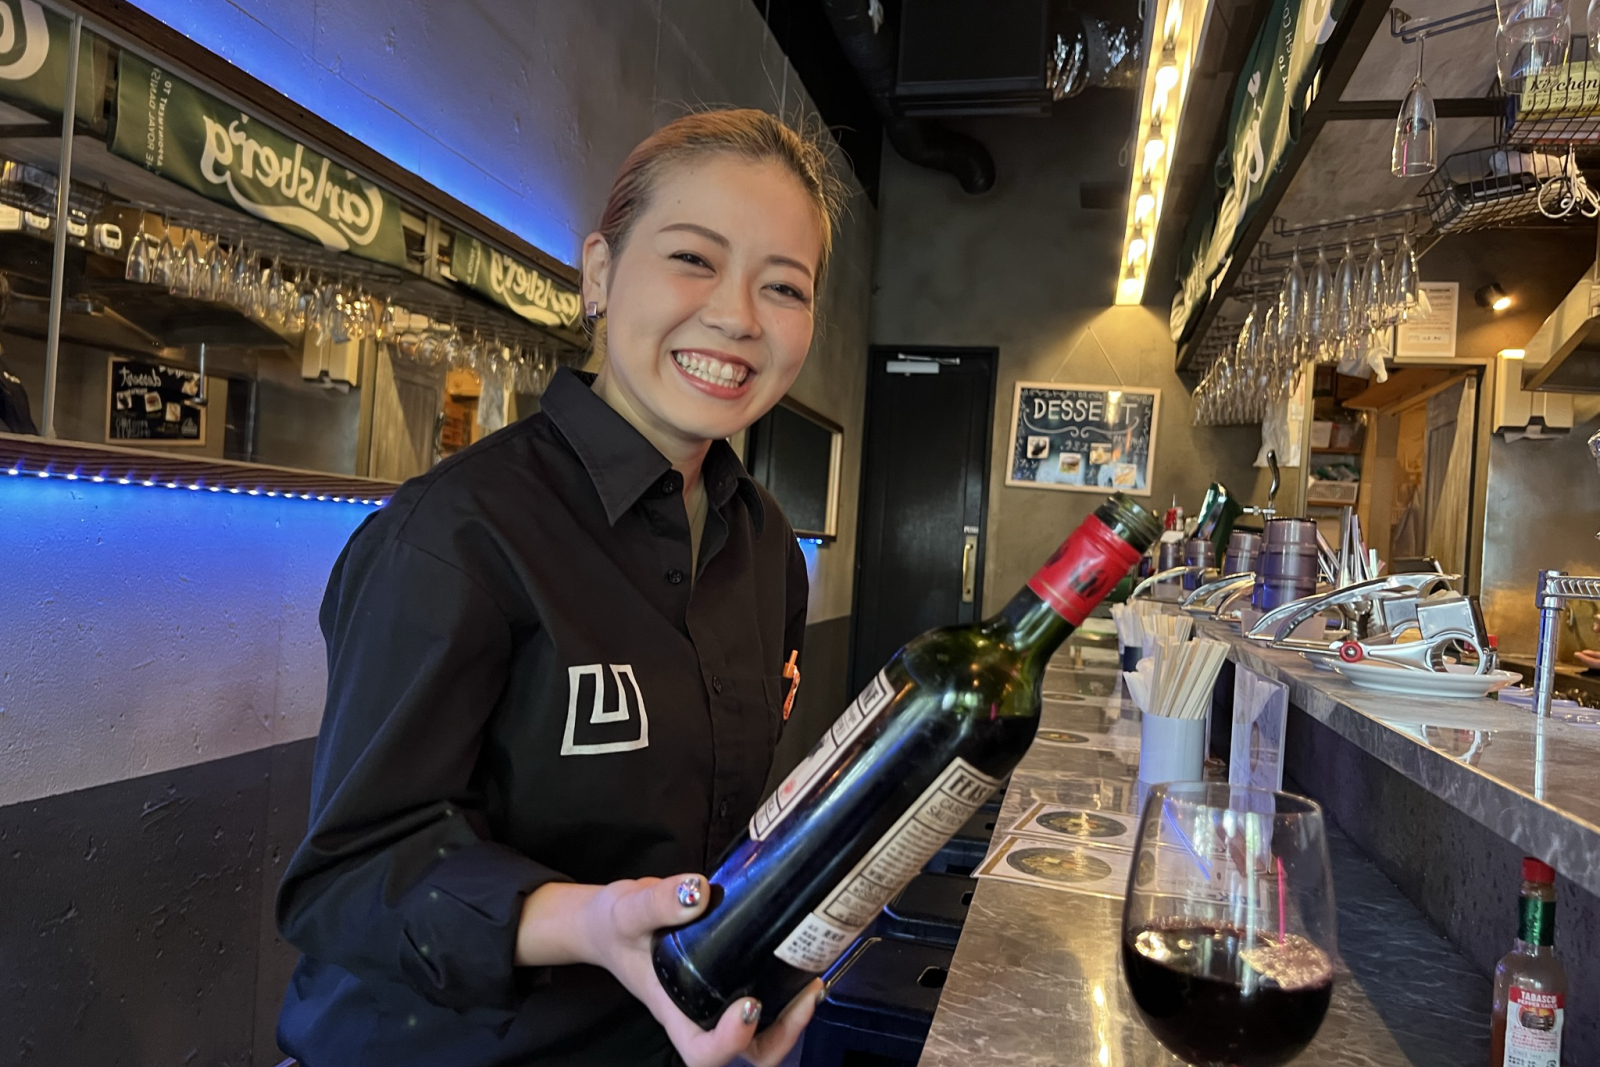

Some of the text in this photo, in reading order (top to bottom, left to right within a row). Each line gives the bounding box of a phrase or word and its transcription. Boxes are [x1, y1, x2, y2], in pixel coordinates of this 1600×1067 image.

[1278, 55, 1286, 72] TO
[1530, 76, 1599, 93] Kitchen
[1520, 990, 1557, 1004] TABASCO
